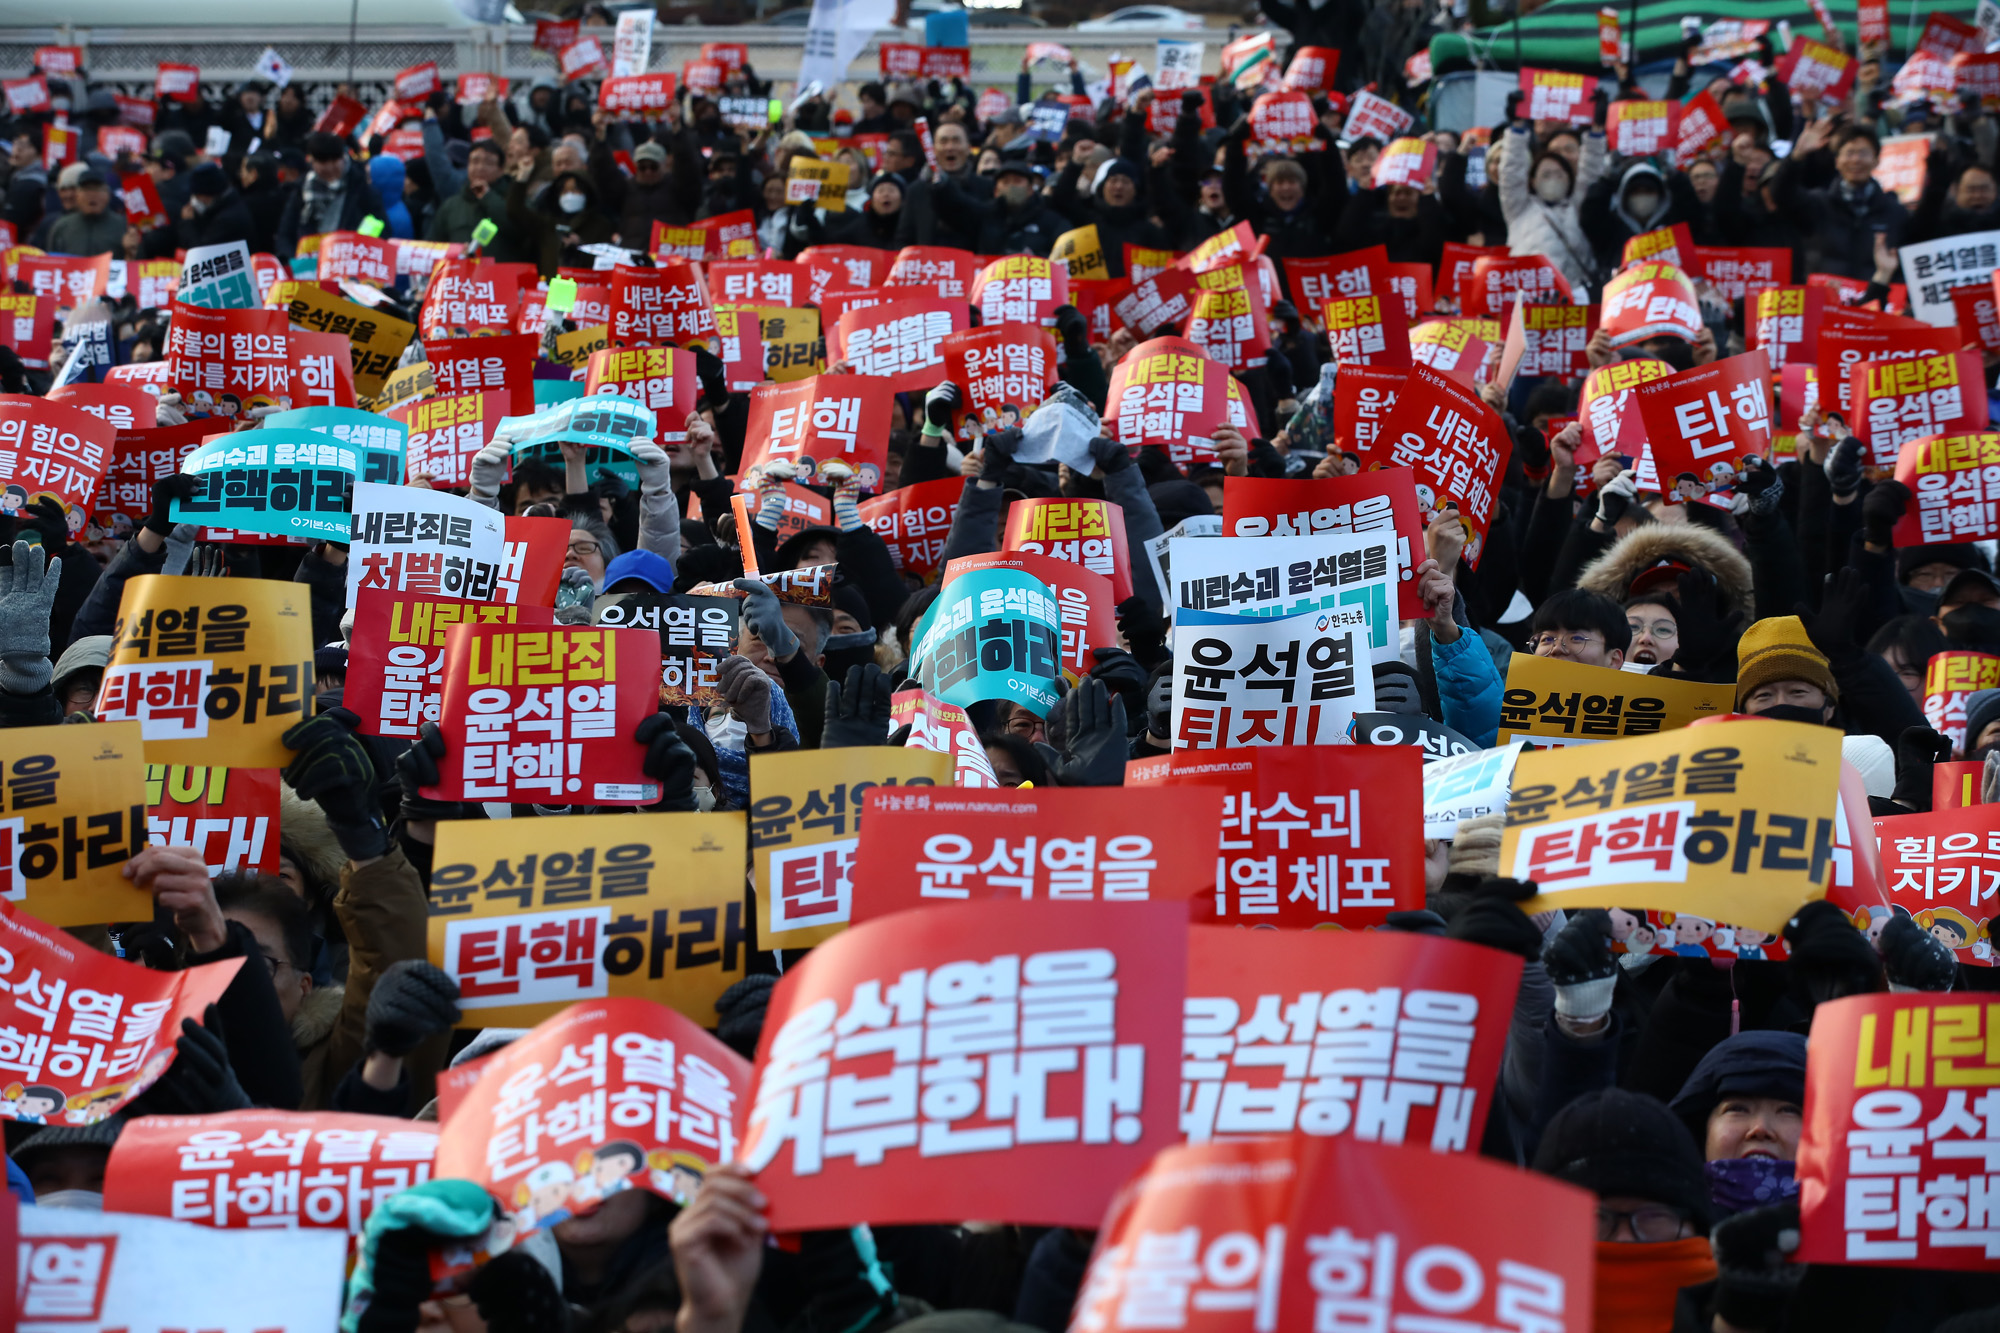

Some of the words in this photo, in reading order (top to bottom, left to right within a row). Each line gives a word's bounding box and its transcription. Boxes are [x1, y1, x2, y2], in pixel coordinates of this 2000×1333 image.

[1533, 72, 1584, 88] 내란죄
[328, 242, 384, 264] 내란수괴
[659, 227, 707, 246] 내란죄
[190, 249, 246, 279] 윤석열을
[987, 256, 1051, 283] 내란죄
[1913, 244, 1997, 279] 윤석열을
[33, 268, 97, 302] 탄핵
[431, 276, 495, 303] 내란수괴
[624, 283, 704, 311] 내란수괴
[725, 272, 793, 307] 탄핵
[983, 277, 1051, 302] 윤석열
[1300, 265, 1372, 311] 탄핵
[289, 299, 379, 345] 윤석열을
[468, 303, 509, 325] 체포
[614, 312, 675, 340] 윤석열
[677, 306, 716, 337] 체포
[981, 300, 1037, 327] 탄핵!
[1189, 313, 1256, 342] 윤석열
[1522, 305, 1587, 330] 내란죄
[171, 326, 226, 361] 촛불의
[231, 332, 289, 361] 힘으로
[766, 341, 820, 369] 하라
[847, 311, 953, 360] 윤석열을
[1525, 327, 1587, 351] 윤석열
[168, 357, 227, 389] 나라를
[231, 363, 290, 392] 지키자
[429, 356, 507, 390] 윤석열을
[598, 348, 674, 384] 내란죄
[963, 343, 1046, 378] 윤석열을
[1124, 354, 1206, 387] 내란죄
[1519, 351, 1572, 376] 탄핵!
[1868, 352, 1959, 399] 내란죄
[968, 373, 1046, 409] 탄핵하라
[1118, 381, 1206, 416] 윤석열
[1446, 386, 1486, 416] www.nanum.com
[1586, 360, 1668, 402] 내란죄
[1641, 380, 1671, 395] 나눔문화
[1671, 369, 1721, 388] www.nanum.com
[406, 392, 484, 435] 내란죄
[768, 396, 862, 455] 탄핵
[1117, 411, 1185, 446] 탄핵!
[1674, 377, 1771, 461] 탄핵
[1868, 384, 1964, 433] 윤석열
[31, 423, 105, 473] 힘으로
[274, 442, 357, 472] 윤석열을
[332, 424, 402, 451] 윤석열을
[405, 420, 485, 460] 윤석열
[1425, 404, 1500, 486] 내란수괴
[1916, 433, 2000, 474] 내란죄
[20, 455, 96, 507] 지키자
[406, 453, 468, 485] 탄핵!
[1390, 432, 1474, 501] 윤석열
[1466, 475, 1493, 526] 체포
[96, 480, 154, 514] 탄핵
[179, 467, 357, 513] 탄핵하라
[351, 510, 472, 550] 내란죄로
[1019, 501, 1111, 542] 내란죄
[1919, 501, 2000, 543] 탄핵!
[358, 551, 501, 603] 처벌하라
[973, 557, 1024, 569] www.nanum.com
[1180, 565, 1280, 612] 내란수괴
[1288, 543, 1388, 596] 윤석열을
[979, 586, 1059, 631] 윤석열을
[1331, 609, 1364, 629] 한국노총
[107, 603, 251, 662] 윤석열을
[468, 630, 617, 688] 내란죄
[1183, 631, 1356, 704] 윤석열
[97, 660, 317, 724] 탄핵하라
[1019, 681, 1060, 709] 기본소득
[1500, 688, 1667, 735] 윤석열을
[464, 684, 617, 745] 윤석열
[462, 741, 585, 799] 탄핵!
[1172, 760, 1253, 776] www.nanum.com
[1505, 745, 1744, 829] 윤석열을
[933, 800, 1038, 815] www.nanum.com
[1424, 805, 1493, 824] 본소득당
[0, 802, 150, 882] 하라
[1526, 808, 1838, 886] 탄핵하라
[427, 843, 656, 916] 윤석열을
[915, 833, 1158, 901] 윤석열을
[1287, 854, 1396, 914] 체포
[456, 901, 747, 998] 탄핵하라
[771, 949, 1119, 1085] 윤석열을
[1181, 986, 1480, 1085] 윤석열을
[493, 1031, 738, 1128] 윤석열을
[741, 1043, 1146, 1176] 거부한다!
[177, 1127, 441, 1172] 윤석열을
[486, 1084, 739, 1183] 탄핵하라
[171, 1162, 432, 1238] 탄핵하라
[1304, 1225, 1565, 1333] 힘으로
